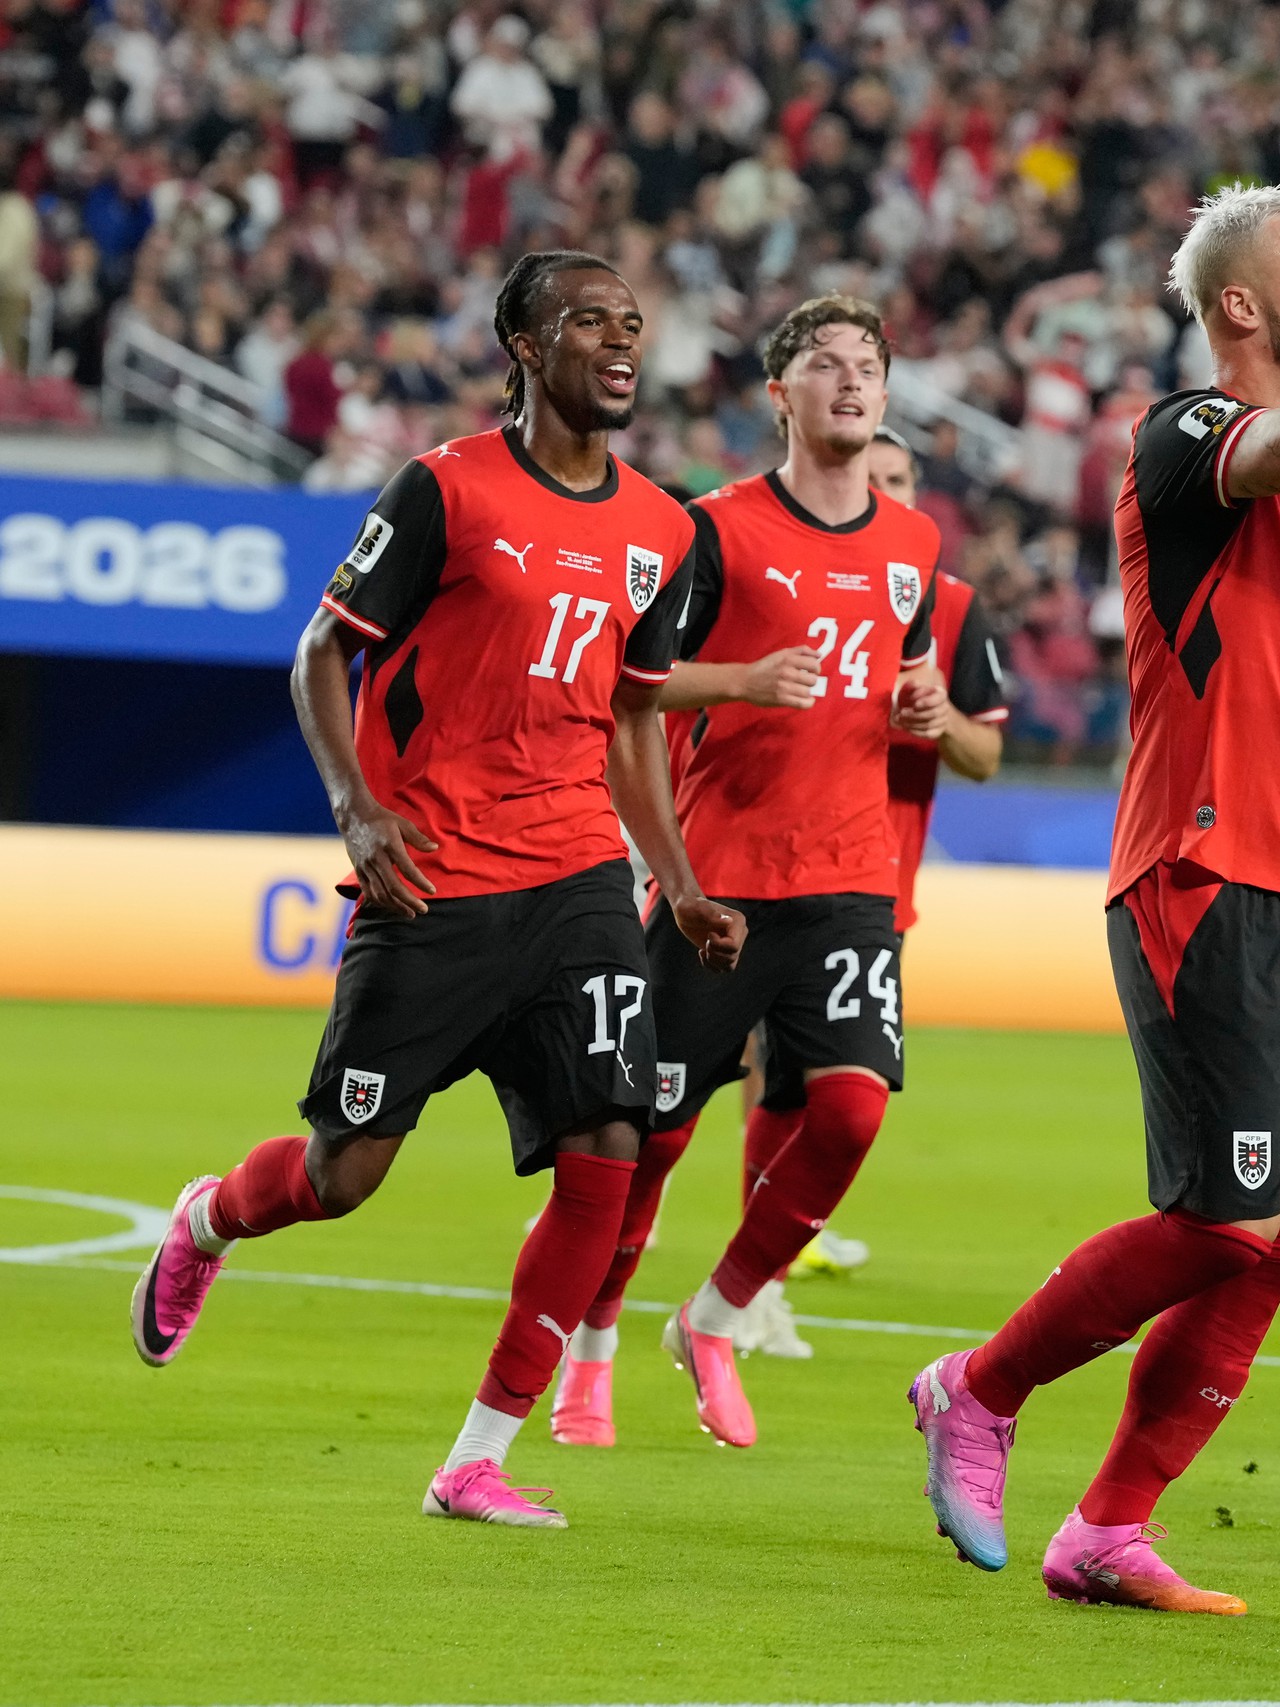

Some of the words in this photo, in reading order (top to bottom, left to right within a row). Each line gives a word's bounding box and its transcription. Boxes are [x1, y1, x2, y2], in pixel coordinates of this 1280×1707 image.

[0, 512, 286, 614] 2026
[528, 592, 612, 684] 17
[807, 617, 875, 699] 24
[581, 974, 647, 1056] 17
[825, 948, 899, 1024] 24
[1198, 1386, 1239, 1409] ÖF
